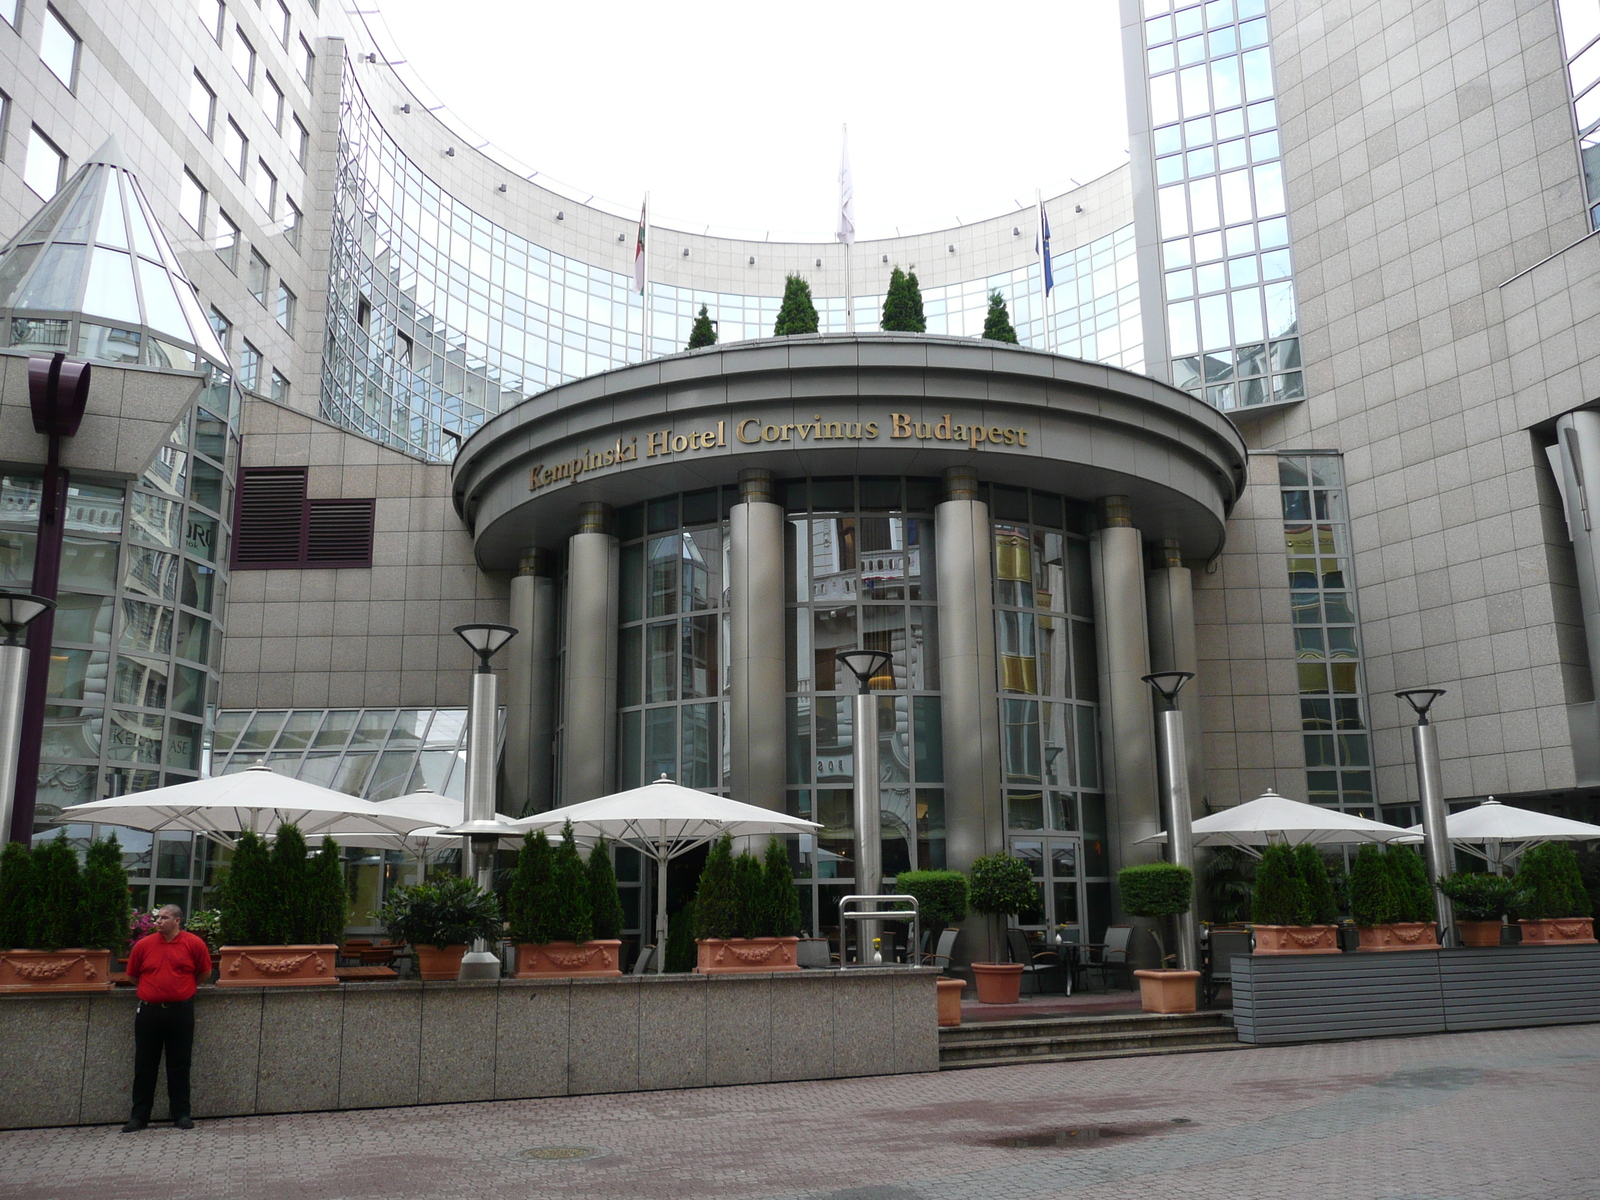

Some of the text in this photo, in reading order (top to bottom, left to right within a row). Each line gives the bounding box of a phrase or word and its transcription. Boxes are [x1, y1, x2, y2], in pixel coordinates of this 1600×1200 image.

[528, 413, 1029, 491] Kempinski Hotel Corvinus Budapest
